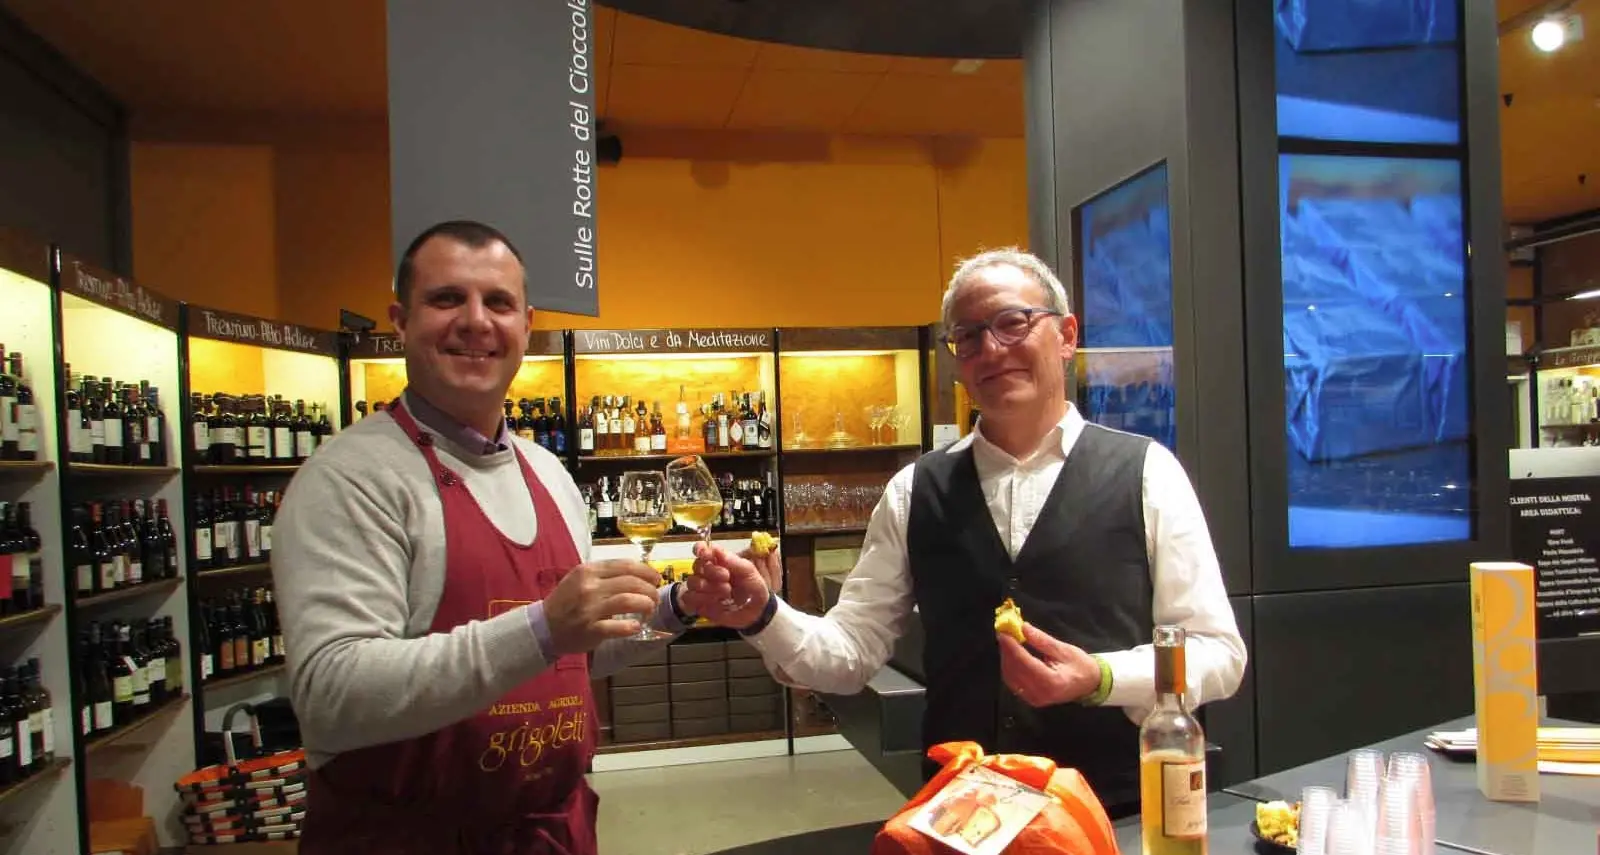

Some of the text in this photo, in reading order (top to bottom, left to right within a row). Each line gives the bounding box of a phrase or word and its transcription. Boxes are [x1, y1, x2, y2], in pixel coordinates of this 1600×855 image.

[569, 101, 590, 141] del
[572, 149, 592, 218] Rotte
[574, 226, 593, 289] Sulle
[584, 332, 610, 350] Vini
[610, 332, 644, 350] Dolci
[650, 333, 660, 349] e
[488, 702, 541, 716] AZIENDA
